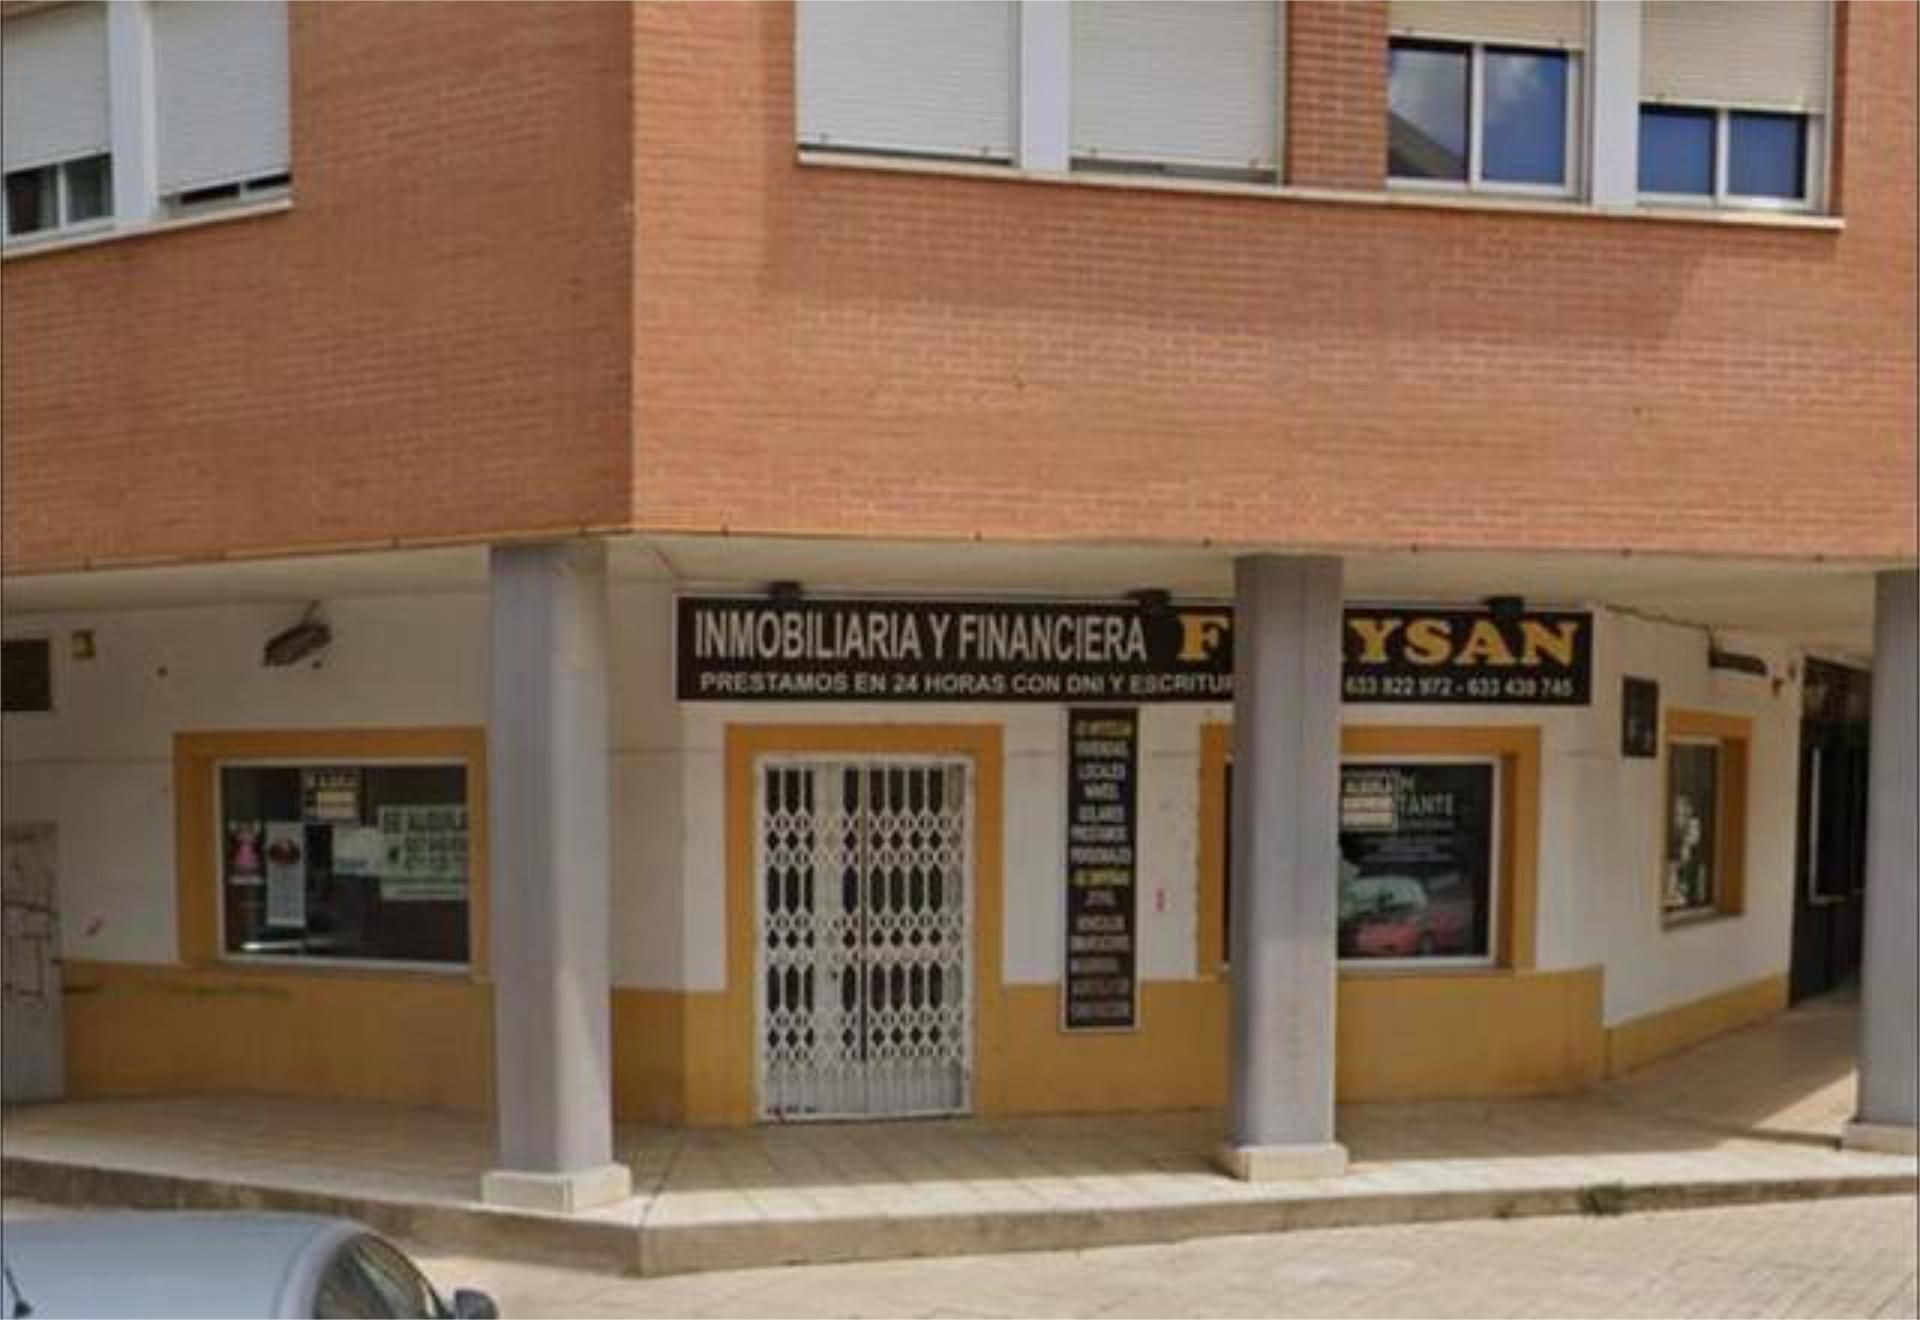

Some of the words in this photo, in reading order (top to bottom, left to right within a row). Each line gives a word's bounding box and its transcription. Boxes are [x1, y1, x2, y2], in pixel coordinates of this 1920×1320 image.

[695, 610, 921, 660] INMOBILIARIA
[928, 613, 950, 660] Y
[959, 614, 1147, 662] FINANCIERA
[701, 671, 848, 694] PRESTAMOS
[855, 672, 886, 694] EN
[894, 672, 918, 694] 24
[924, 672, 1004, 695] HORAS
[1012, 673, 1060, 695] CON
[1067, 674, 1104, 695] DNI
[1110, 674, 1125, 695] Y
[1346, 676, 1378, 697] 633
[1466, 676, 1500, 697] 633
